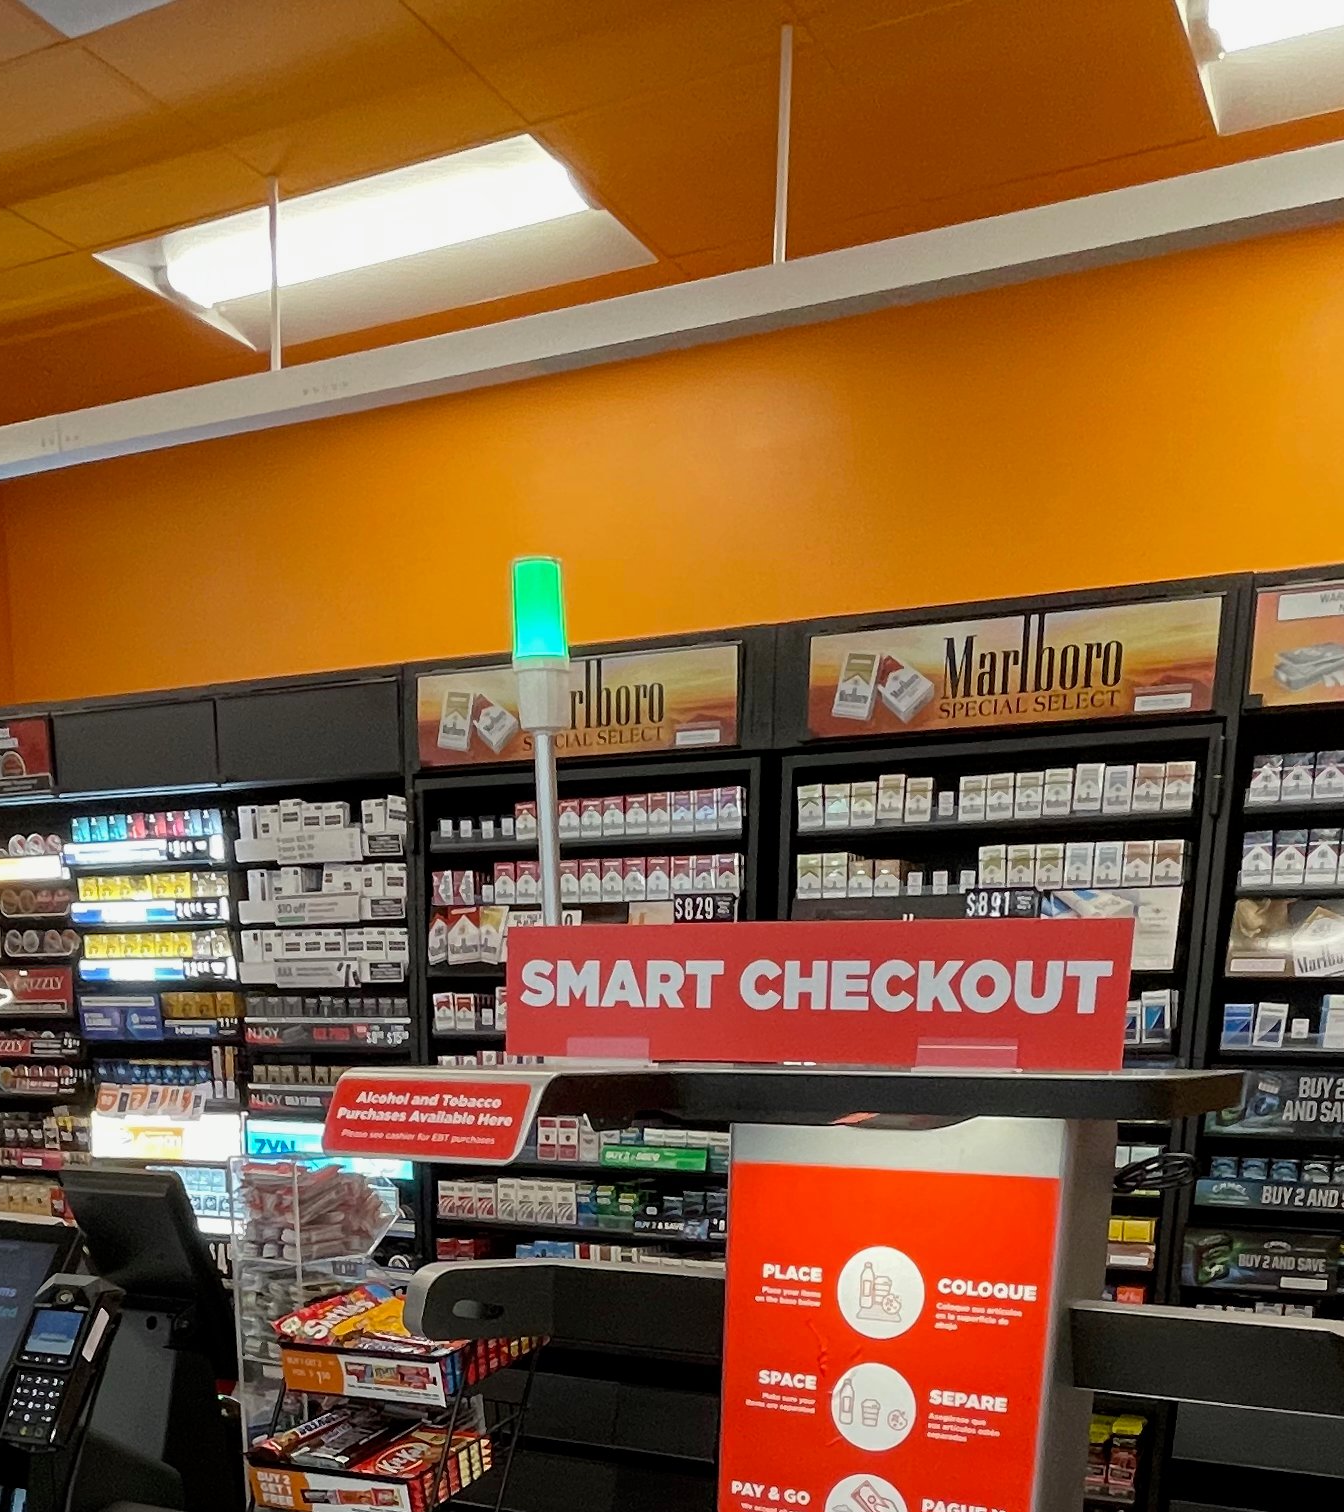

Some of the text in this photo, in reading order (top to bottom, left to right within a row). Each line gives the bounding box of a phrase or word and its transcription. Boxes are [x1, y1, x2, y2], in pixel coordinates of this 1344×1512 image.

[940, 612, 1124, 700] Marlboro
[568, 659, 665, 730] rlboro
[938, 689, 1122, 720] SPECIAL SELECT
[522, 726, 663, 751] SCIAL SELECT
[519, 957, 1114, 1015] SMART CHECKOUT
[246, 1026, 280, 1040] NJOY
[1298, 1076, 1333, 1099] BUY
[250, 1092, 284, 1106] NJOY
[355, 1090, 503, 1109] Alcohol and Tobacco
[336, 1106, 513, 1127] Purchases Available Here
[1282, 1100, 1317, 1122] AND
[253, 1138, 297, 1155] ZYN
[1260, 1185, 1292, 1206] BUY
[1293, 1187, 1306, 1207] 2
[1306, 1188, 1339, 1208] AND
[1237, 1253, 1327, 1273] BUY 2 AND SAVE
[762, 1263, 1038, 1302] PLACE COLOQUE
[758, 1369, 1009, 1414] SPACE SEPARE
[257, 1470, 291, 1485] BUY 2
[260, 1482, 283, 1494] GET
[263, 1494, 294, 1507] FREE
[731, 1480, 765, 1498] PAY
[767, 1486, 780, 1501] &
[783, 1488, 811, 1506] GO
